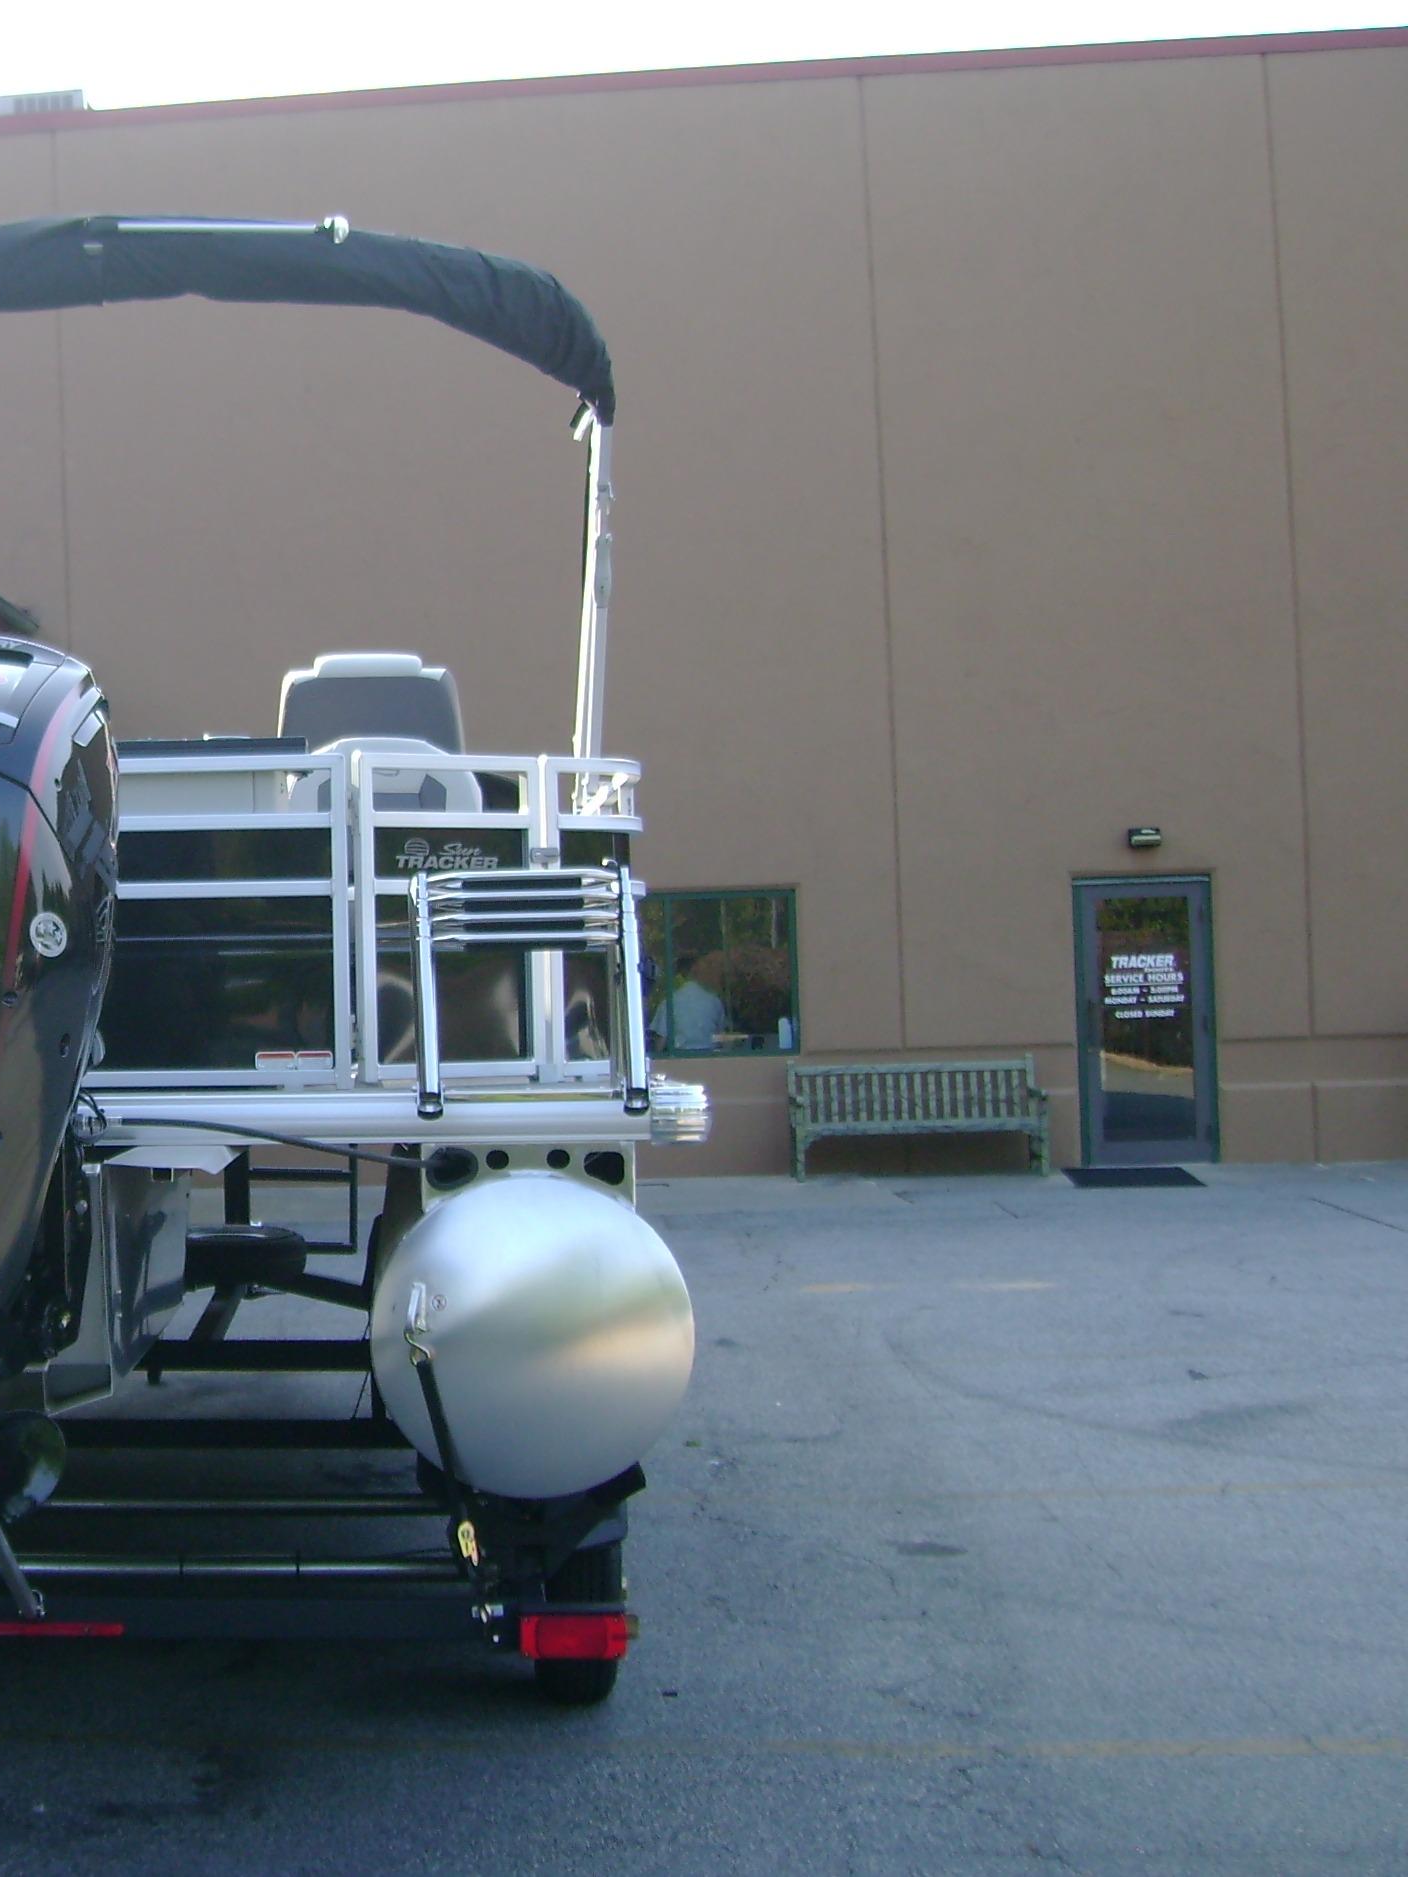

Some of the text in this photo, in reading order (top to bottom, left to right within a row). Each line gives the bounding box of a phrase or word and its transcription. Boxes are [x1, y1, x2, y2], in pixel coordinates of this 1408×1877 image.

[439, 842, 481, 856] Sun
[395, 855, 498, 870] TRACKER
[1110, 954, 1175, 969] TRACKER
[1104, 972, 1184, 985] SERVICE HOURS
[1115, 1010, 1143, 1018] CLOSED
